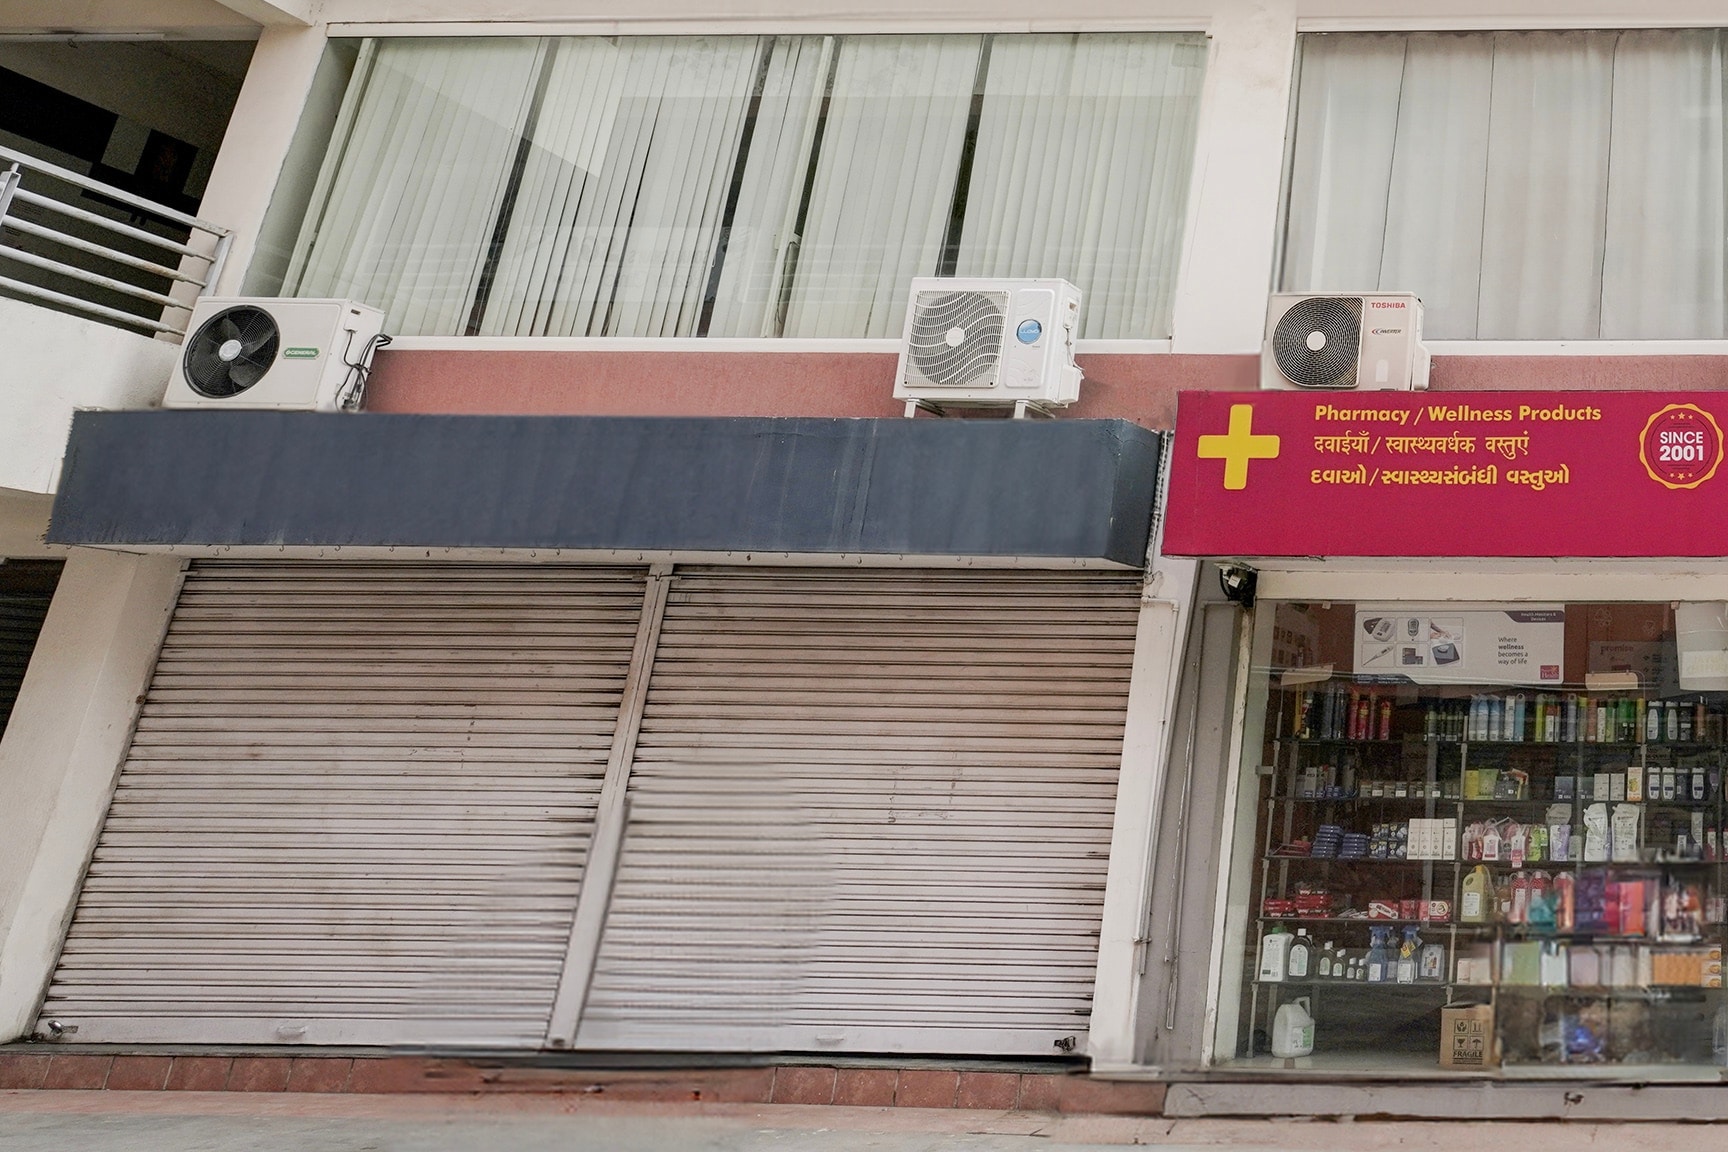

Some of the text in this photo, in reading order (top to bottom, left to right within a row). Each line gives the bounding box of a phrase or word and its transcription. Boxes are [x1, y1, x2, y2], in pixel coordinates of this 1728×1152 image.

[1315, 405, 1410, 425] Pharmacy
[1428, 406, 1512, 421] Wellness
[1519, 404, 1602, 421] Products
[1660, 431, 1704, 444] SINCE
[1659, 445, 1704, 462] 2001
[1453, 1050, 1484, 1058] FRAGILE
